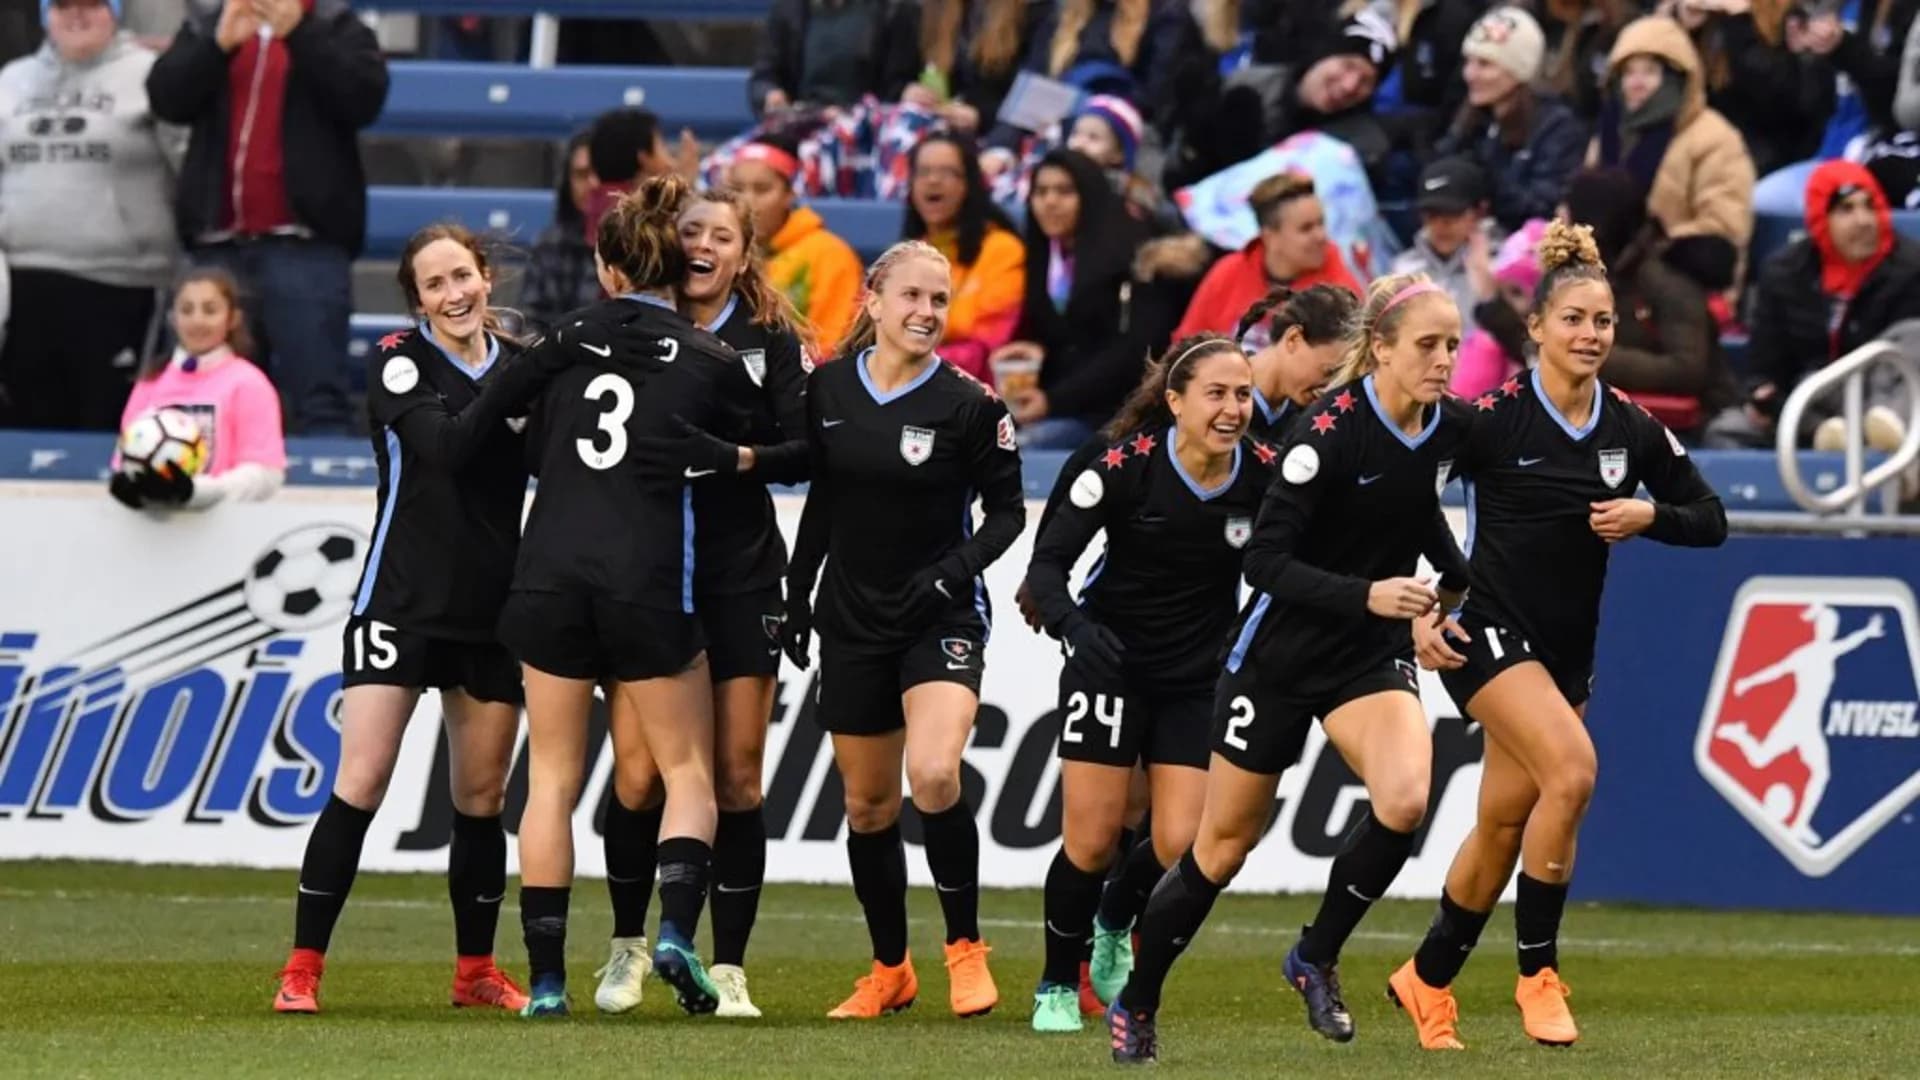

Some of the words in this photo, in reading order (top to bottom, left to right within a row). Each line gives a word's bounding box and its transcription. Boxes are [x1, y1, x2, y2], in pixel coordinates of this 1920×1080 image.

[576, 373, 635, 469] 3
[355, 620, 398, 670] 15
[1063, 691, 1124, 748] 24
[1224, 695, 1256, 751] 2
[1825, 700, 1920, 737] NWSL
